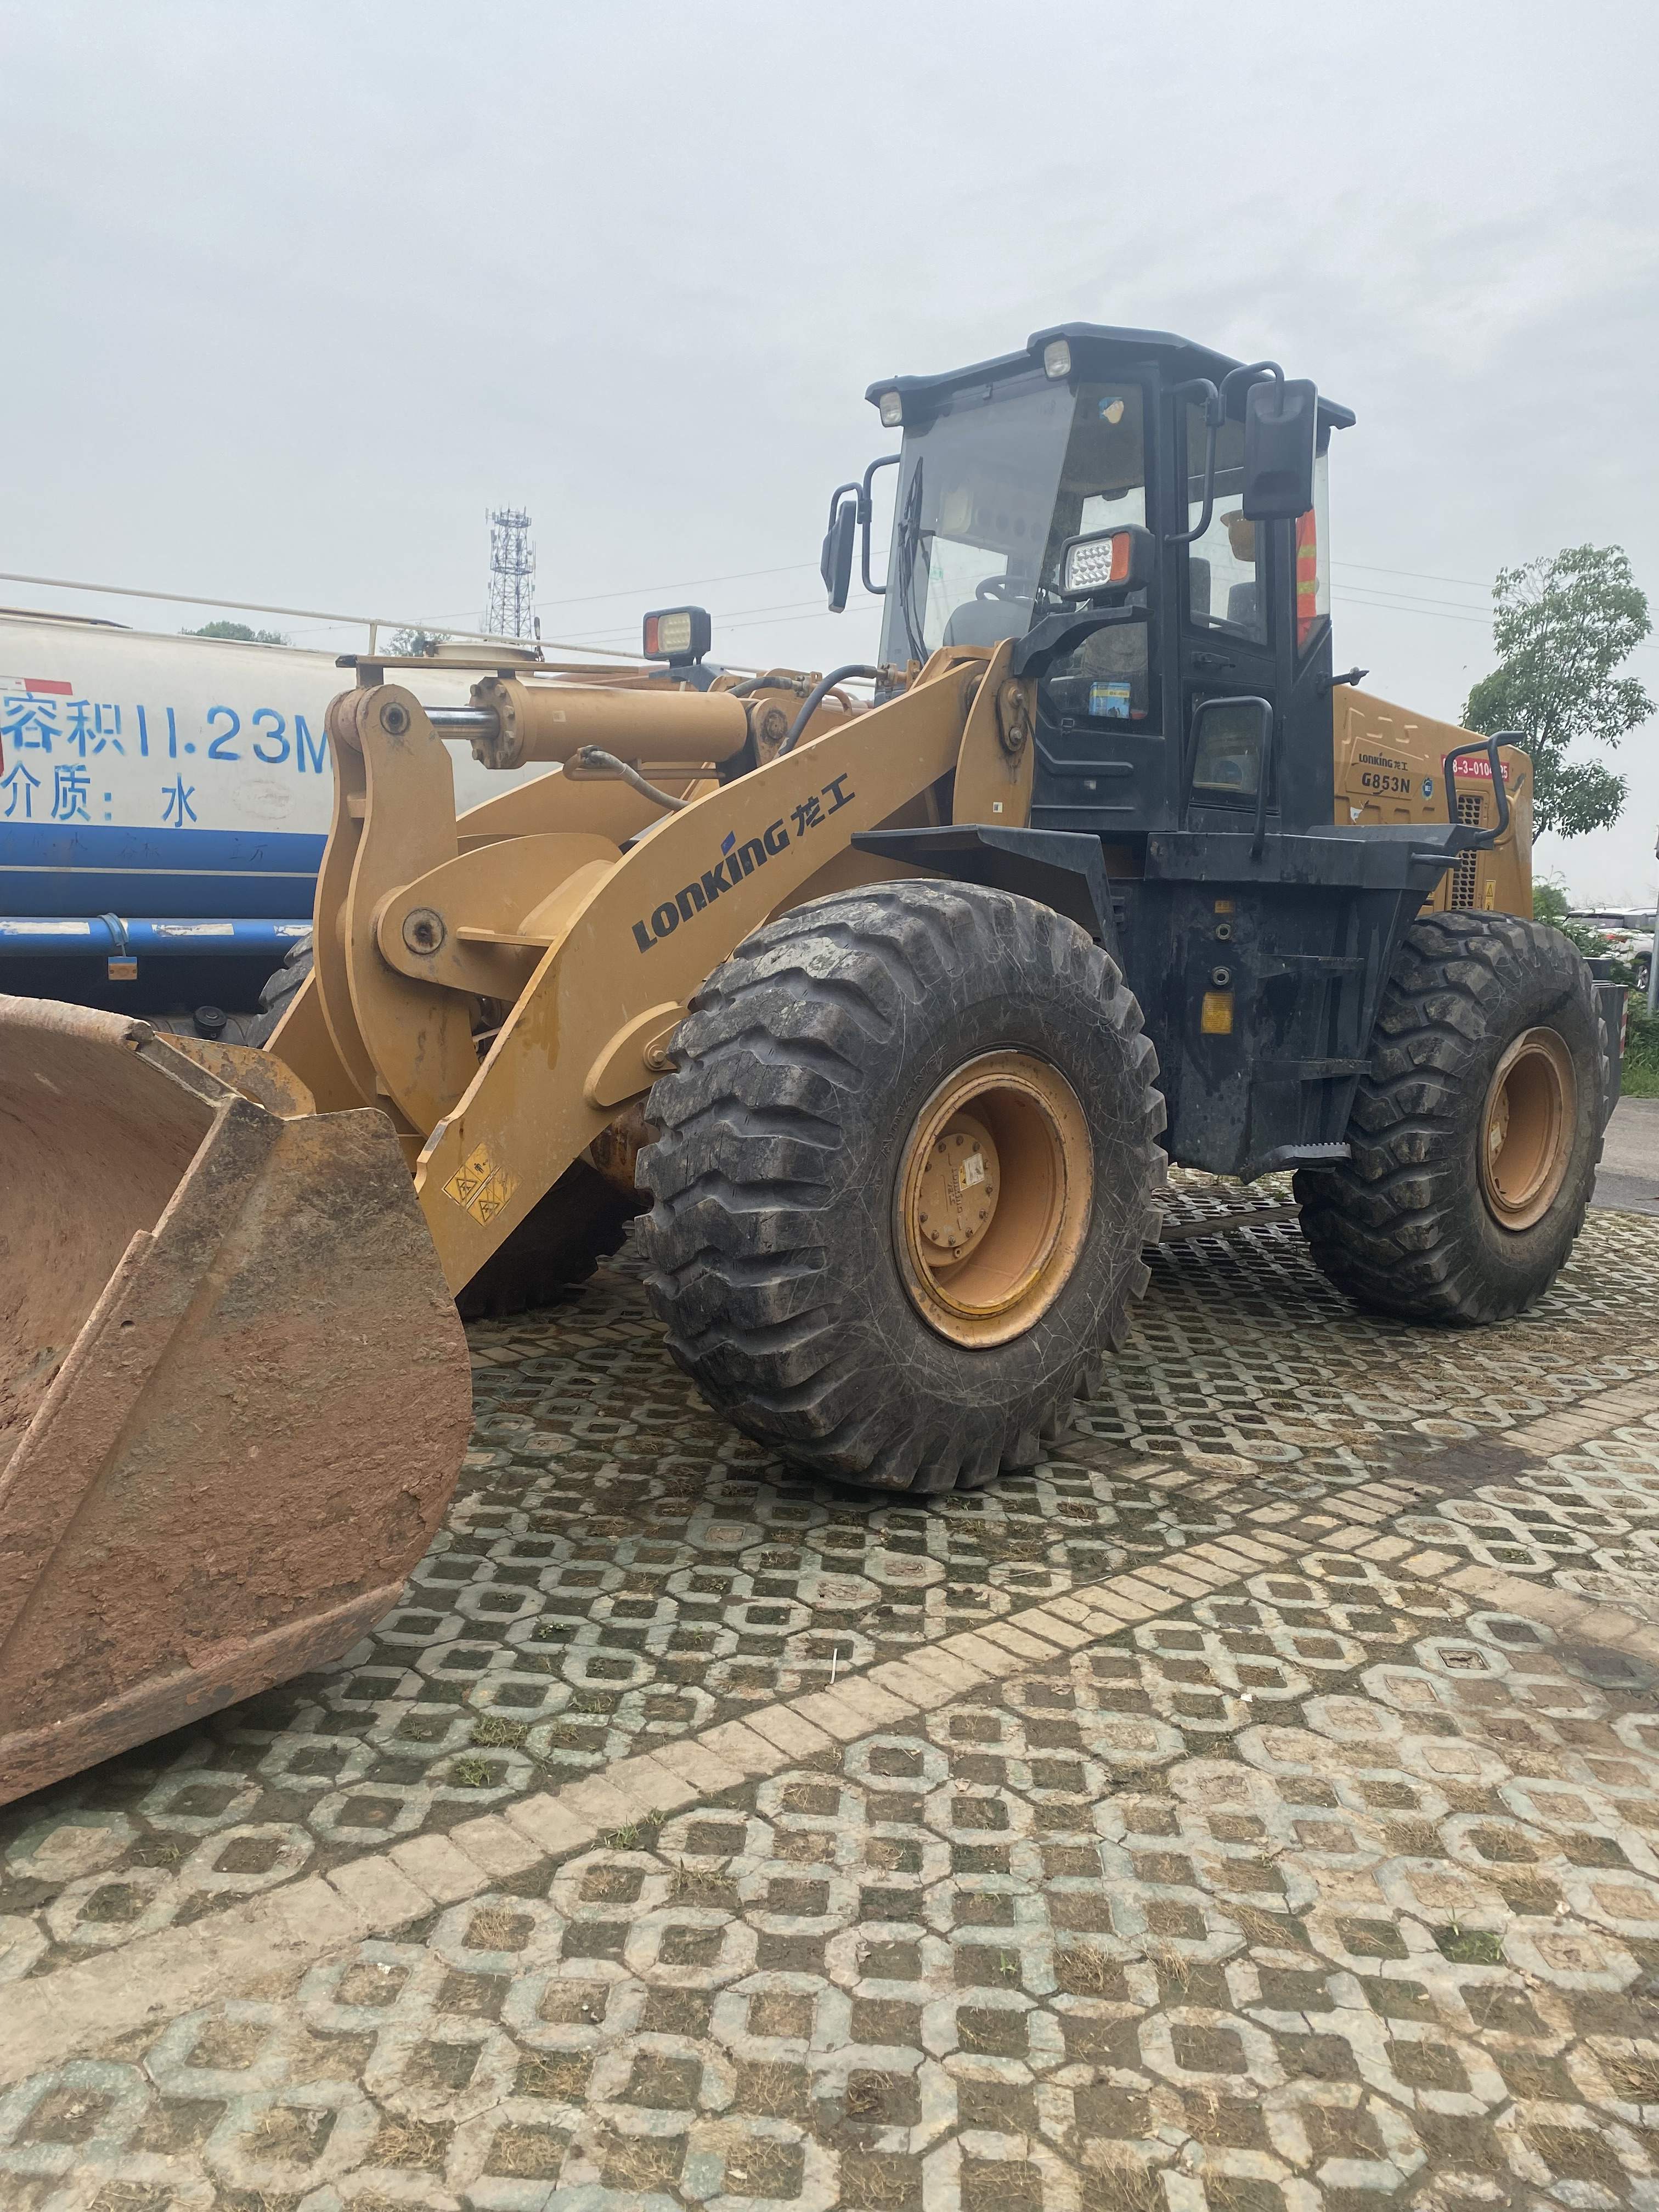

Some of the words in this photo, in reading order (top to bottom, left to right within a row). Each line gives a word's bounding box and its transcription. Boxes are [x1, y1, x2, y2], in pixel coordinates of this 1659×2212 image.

[161, 772, 195, 828] 水
[790, 772, 856, 837] 龙工
[1362, 772, 1410, 793] G853N
